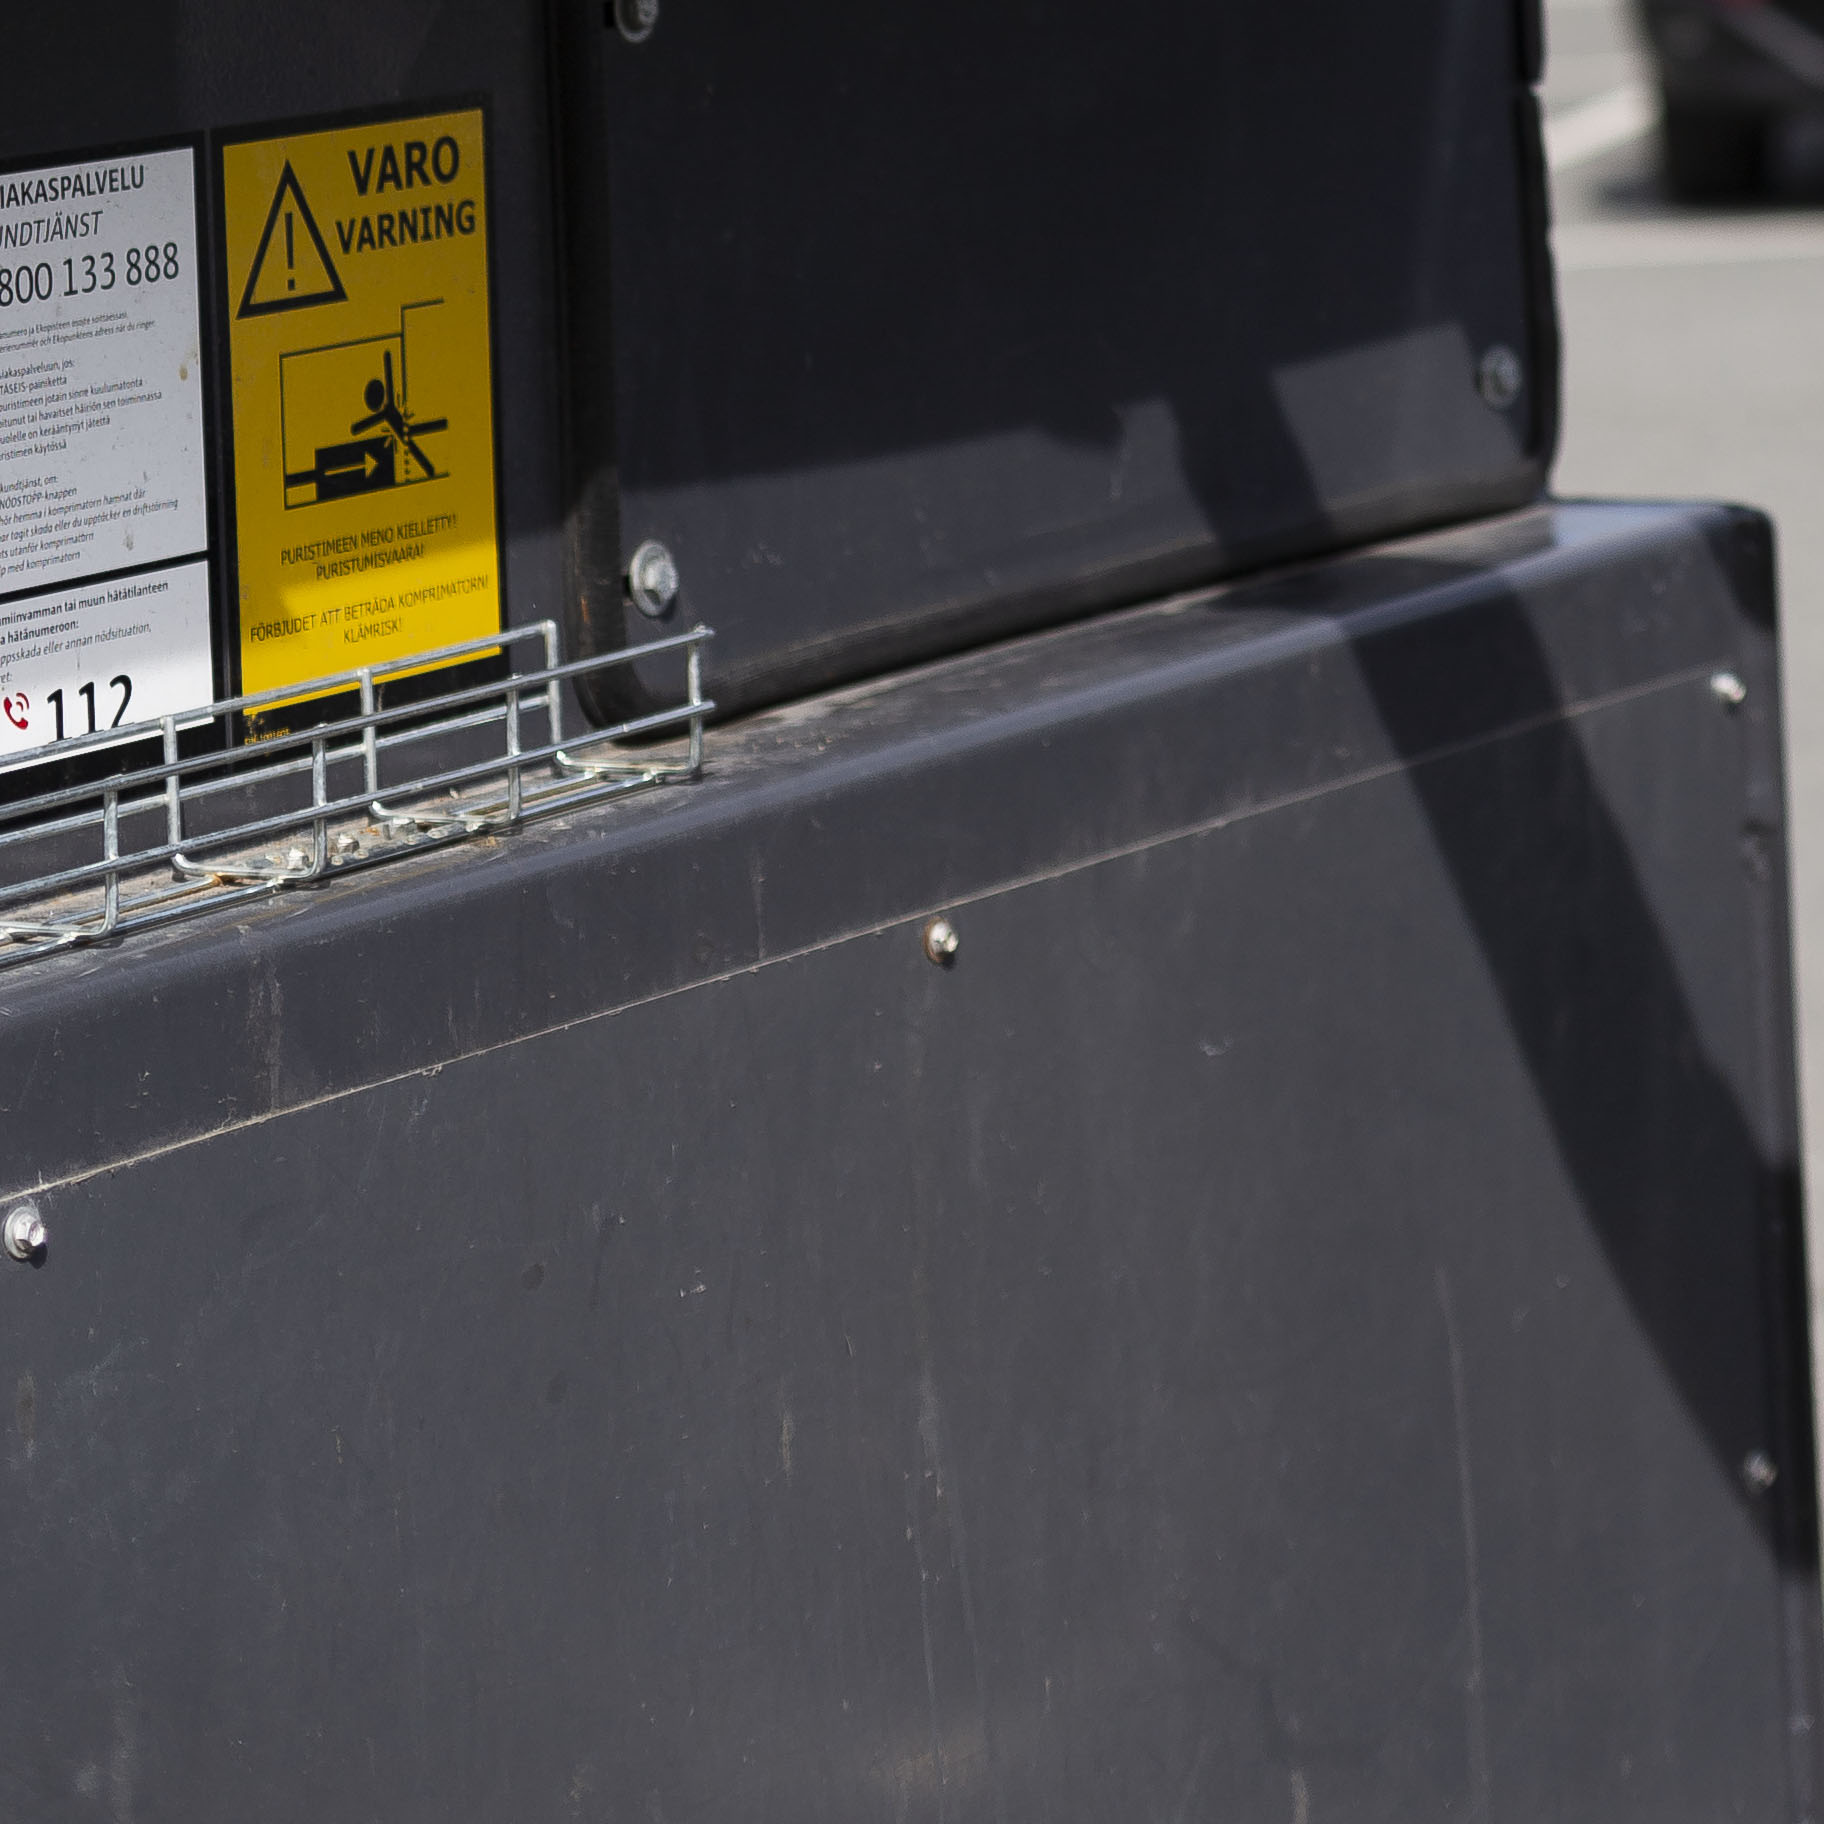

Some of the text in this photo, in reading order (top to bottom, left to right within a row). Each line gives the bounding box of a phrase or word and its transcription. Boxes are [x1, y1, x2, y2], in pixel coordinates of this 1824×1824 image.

[347, 136, 459, 197] VARO
[336, 199, 476, 256] VARNING
[62, 252, 115, 296] 133
[126, 242, 179, 286] 888
[27, 412, 38, 423] tai
[38, 407, 74, 421] havaitset
[74, 402, 102, 415] häiriön
[103, 400, 116, 409] sen
[117, 390, 162, 406] toiminnassa
[45, 391, 67, 406] jotain
[68, 387, 89, 400] sinne
[90, 377, 143, 395] kuulumatonta
[28, 429, 38, 439] on
[13, 510, 42, 523] hemma
[48, 497, 103, 518] komprimatorn
[104, 491, 132, 506] hamnat
[134, 488, 146, 500] där
[280, 512, 458, 566] PURISTIMEEN MENO KIELLETTY!
[316, 543, 424, 581] PURISTUMISVAARA!
[64, 599, 77, 612] tai
[78, 594, 105, 609] muun
[107, 581, 169, 602] hätätilanteen
[250, 574, 488, 643] FÖRBJUDET ATT BETRÄDA KOMPRIMATORN!
[7, 620, 79, 644] hätänumeroon:
[43, 641, 64, 655] eller
[65, 634, 93, 650] annan
[95, 622, 151, 644] nödsituation,
[343, 618, 402, 644] KLÄMRISK!
[47, 674, 135, 743] 112
